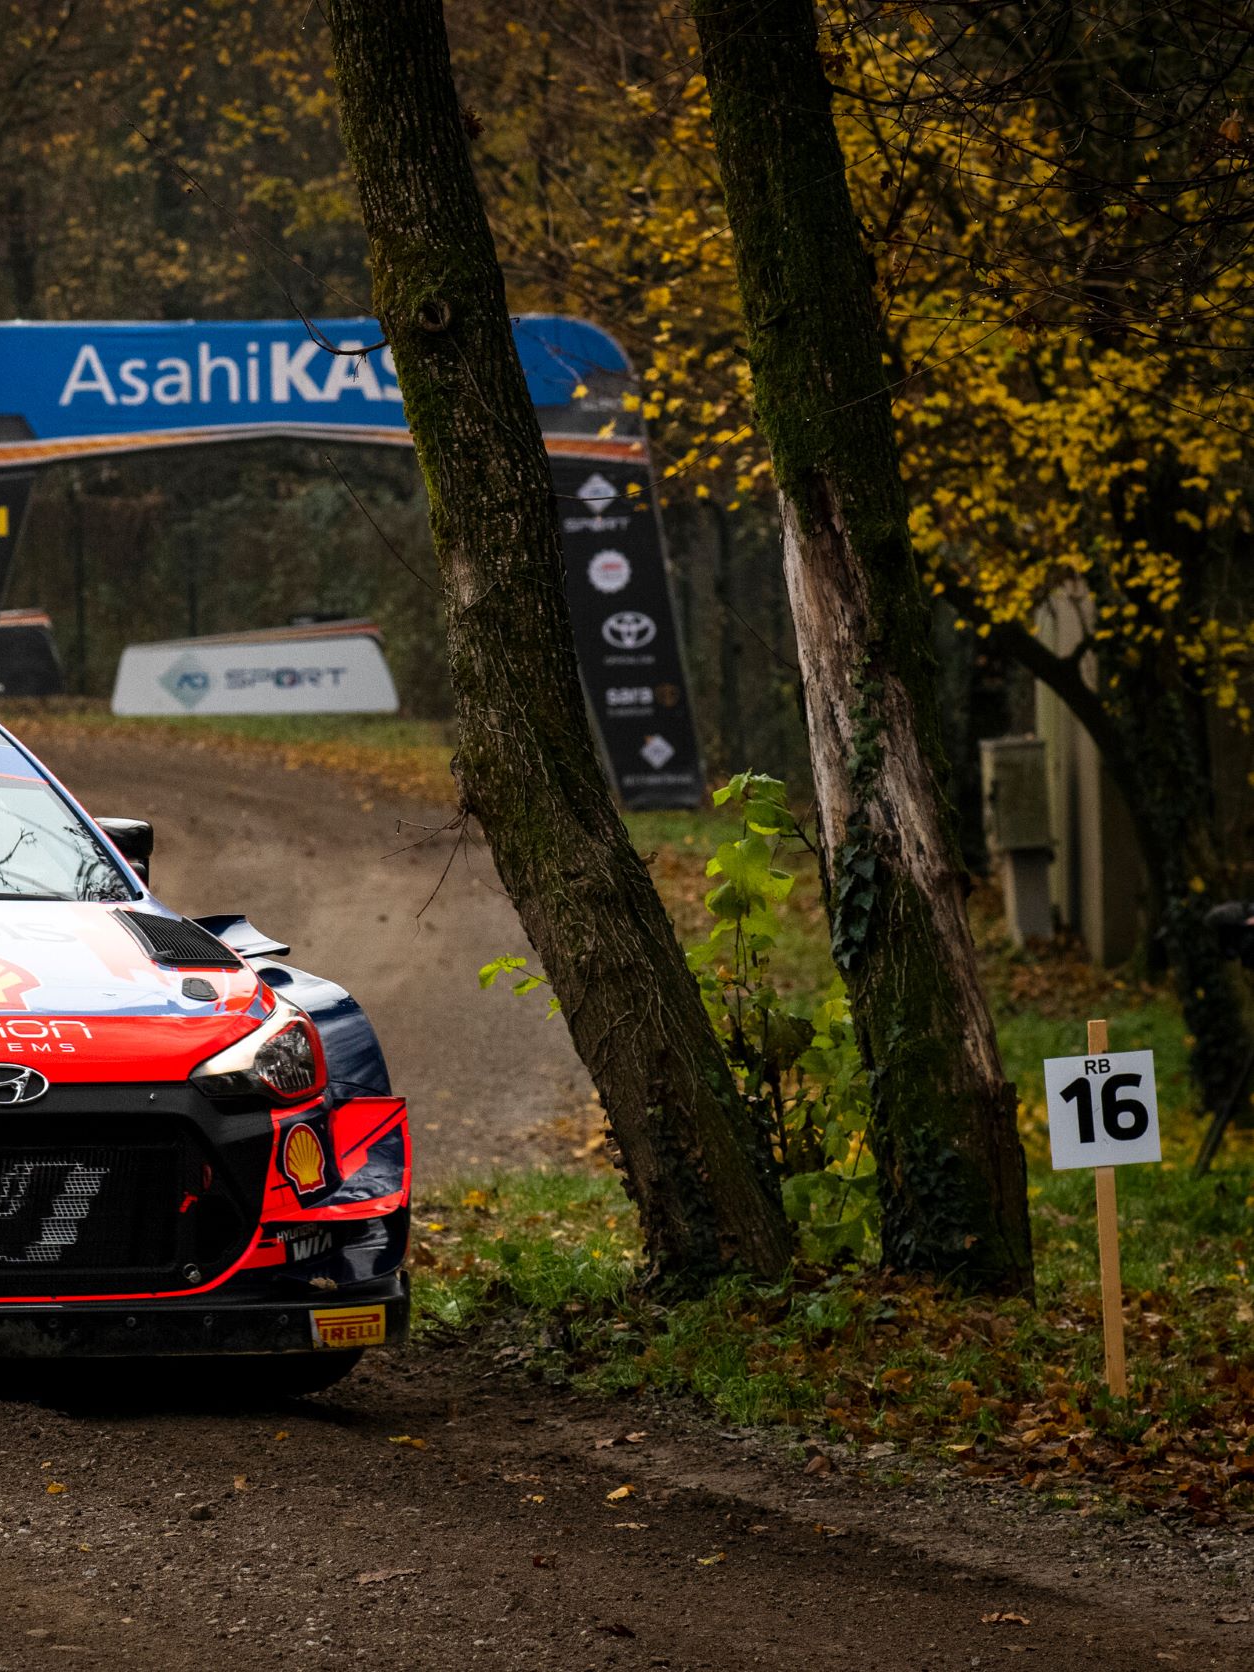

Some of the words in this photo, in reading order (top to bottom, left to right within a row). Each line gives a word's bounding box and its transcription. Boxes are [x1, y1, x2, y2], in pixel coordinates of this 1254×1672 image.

[224, 666, 347, 691] SPORT
[1084, 1058, 1111, 1075] RB
[1059, 1072, 1149, 1144] 16
[293, 1229, 333, 1261] WIA
